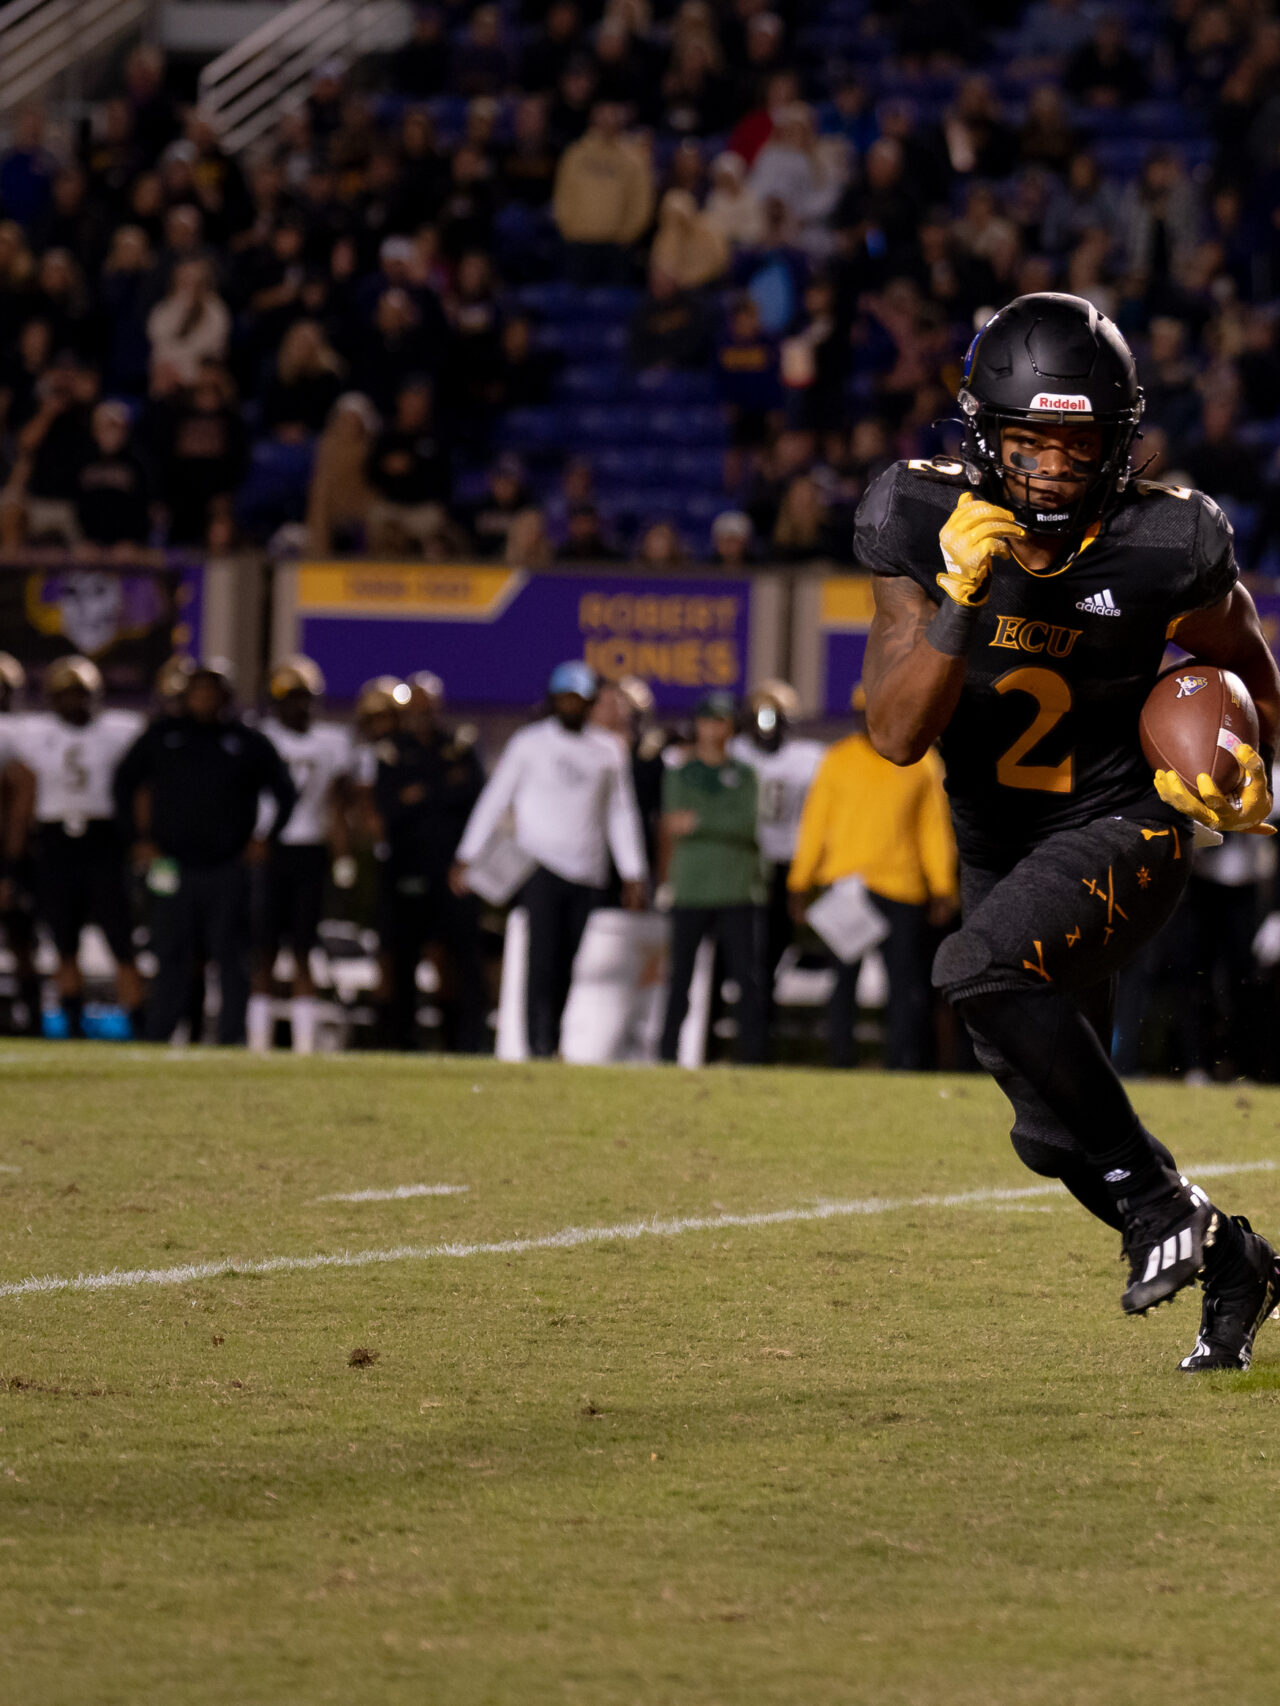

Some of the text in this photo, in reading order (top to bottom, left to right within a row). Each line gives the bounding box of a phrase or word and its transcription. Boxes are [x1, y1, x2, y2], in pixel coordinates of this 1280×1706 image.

[1039, 397, 1086, 410] Riddell
[1036, 513, 1069, 522] Riddell
[578, 593, 738, 633] ROBERT
[1075, 601, 1121, 617] adidas
[988, 615, 1083, 658] ECU
[990, 666, 1074, 793] 2
